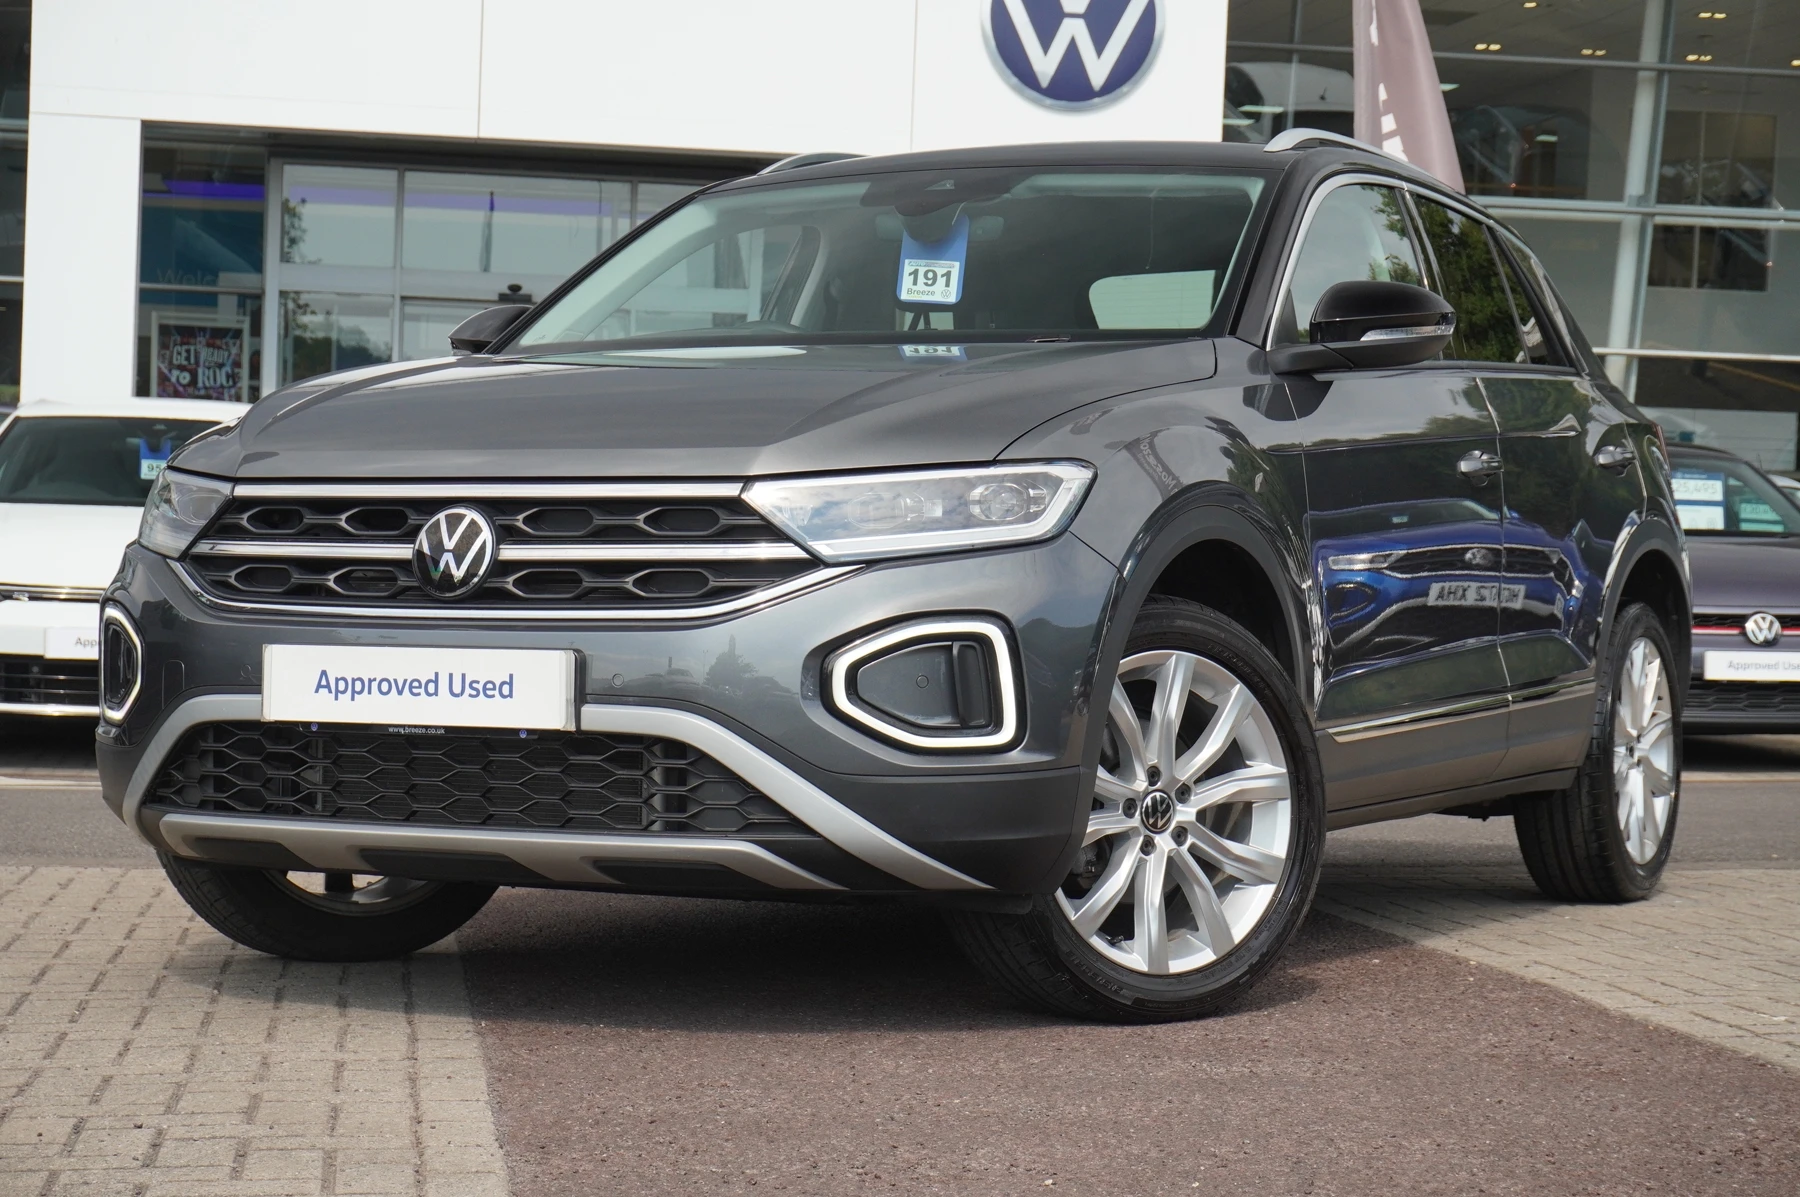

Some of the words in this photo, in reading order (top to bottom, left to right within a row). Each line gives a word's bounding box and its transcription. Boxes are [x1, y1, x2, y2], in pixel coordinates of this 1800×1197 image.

[908, 268, 952, 288] 191
[907, 288, 935, 296] Breeze
[173, 345, 197, 366] GET
[1728, 660, 1780, 672] Approved
[314, 669, 440, 702] Approved
[447, 672, 514, 699] Used
[388, 725, 445, 735] www.breeze.co.uk
